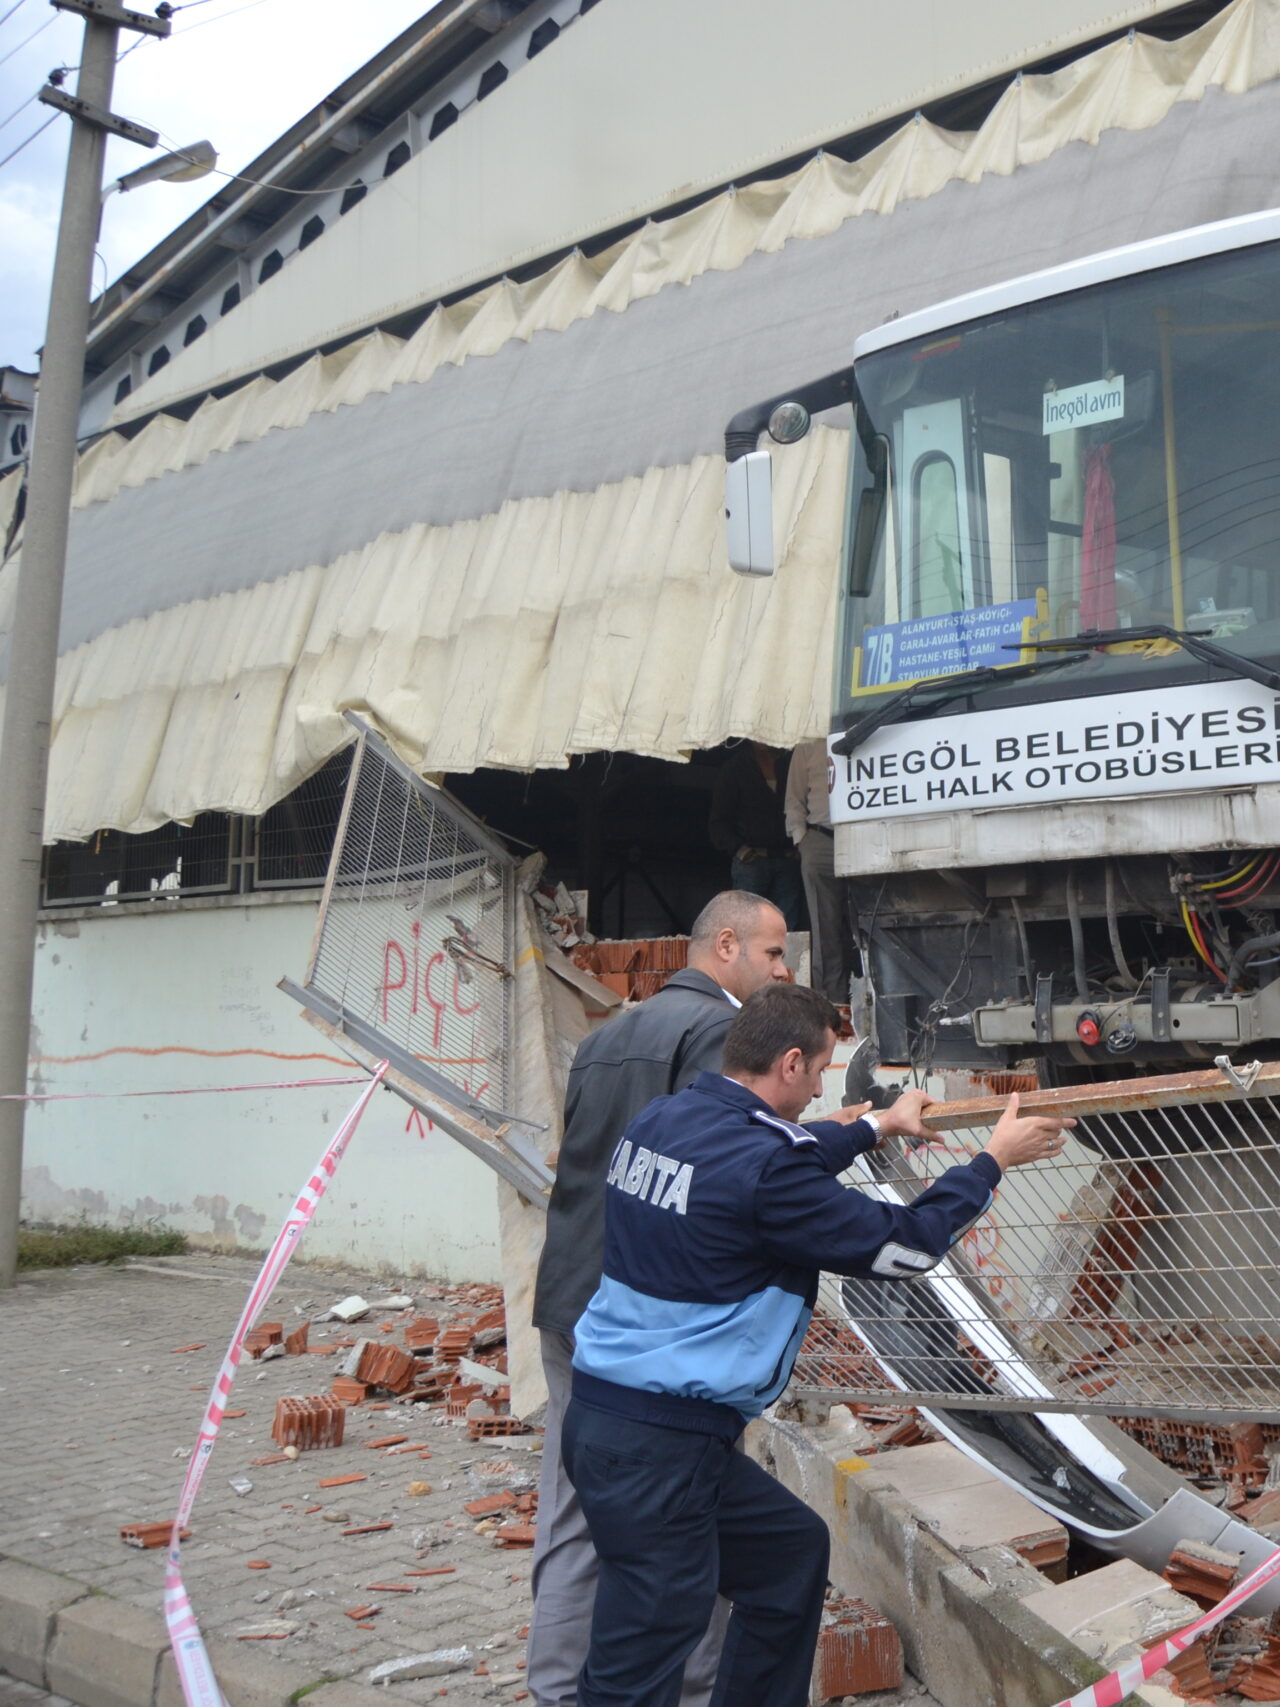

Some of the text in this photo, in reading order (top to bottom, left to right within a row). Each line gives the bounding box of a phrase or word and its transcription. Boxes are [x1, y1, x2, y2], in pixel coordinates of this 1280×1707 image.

[865, 632, 894, 687] 7/B
[847, 784, 917, 811] ÖZEL
[926, 770, 1014, 801] HALK
[607, 1136, 694, 1215] ABITA
